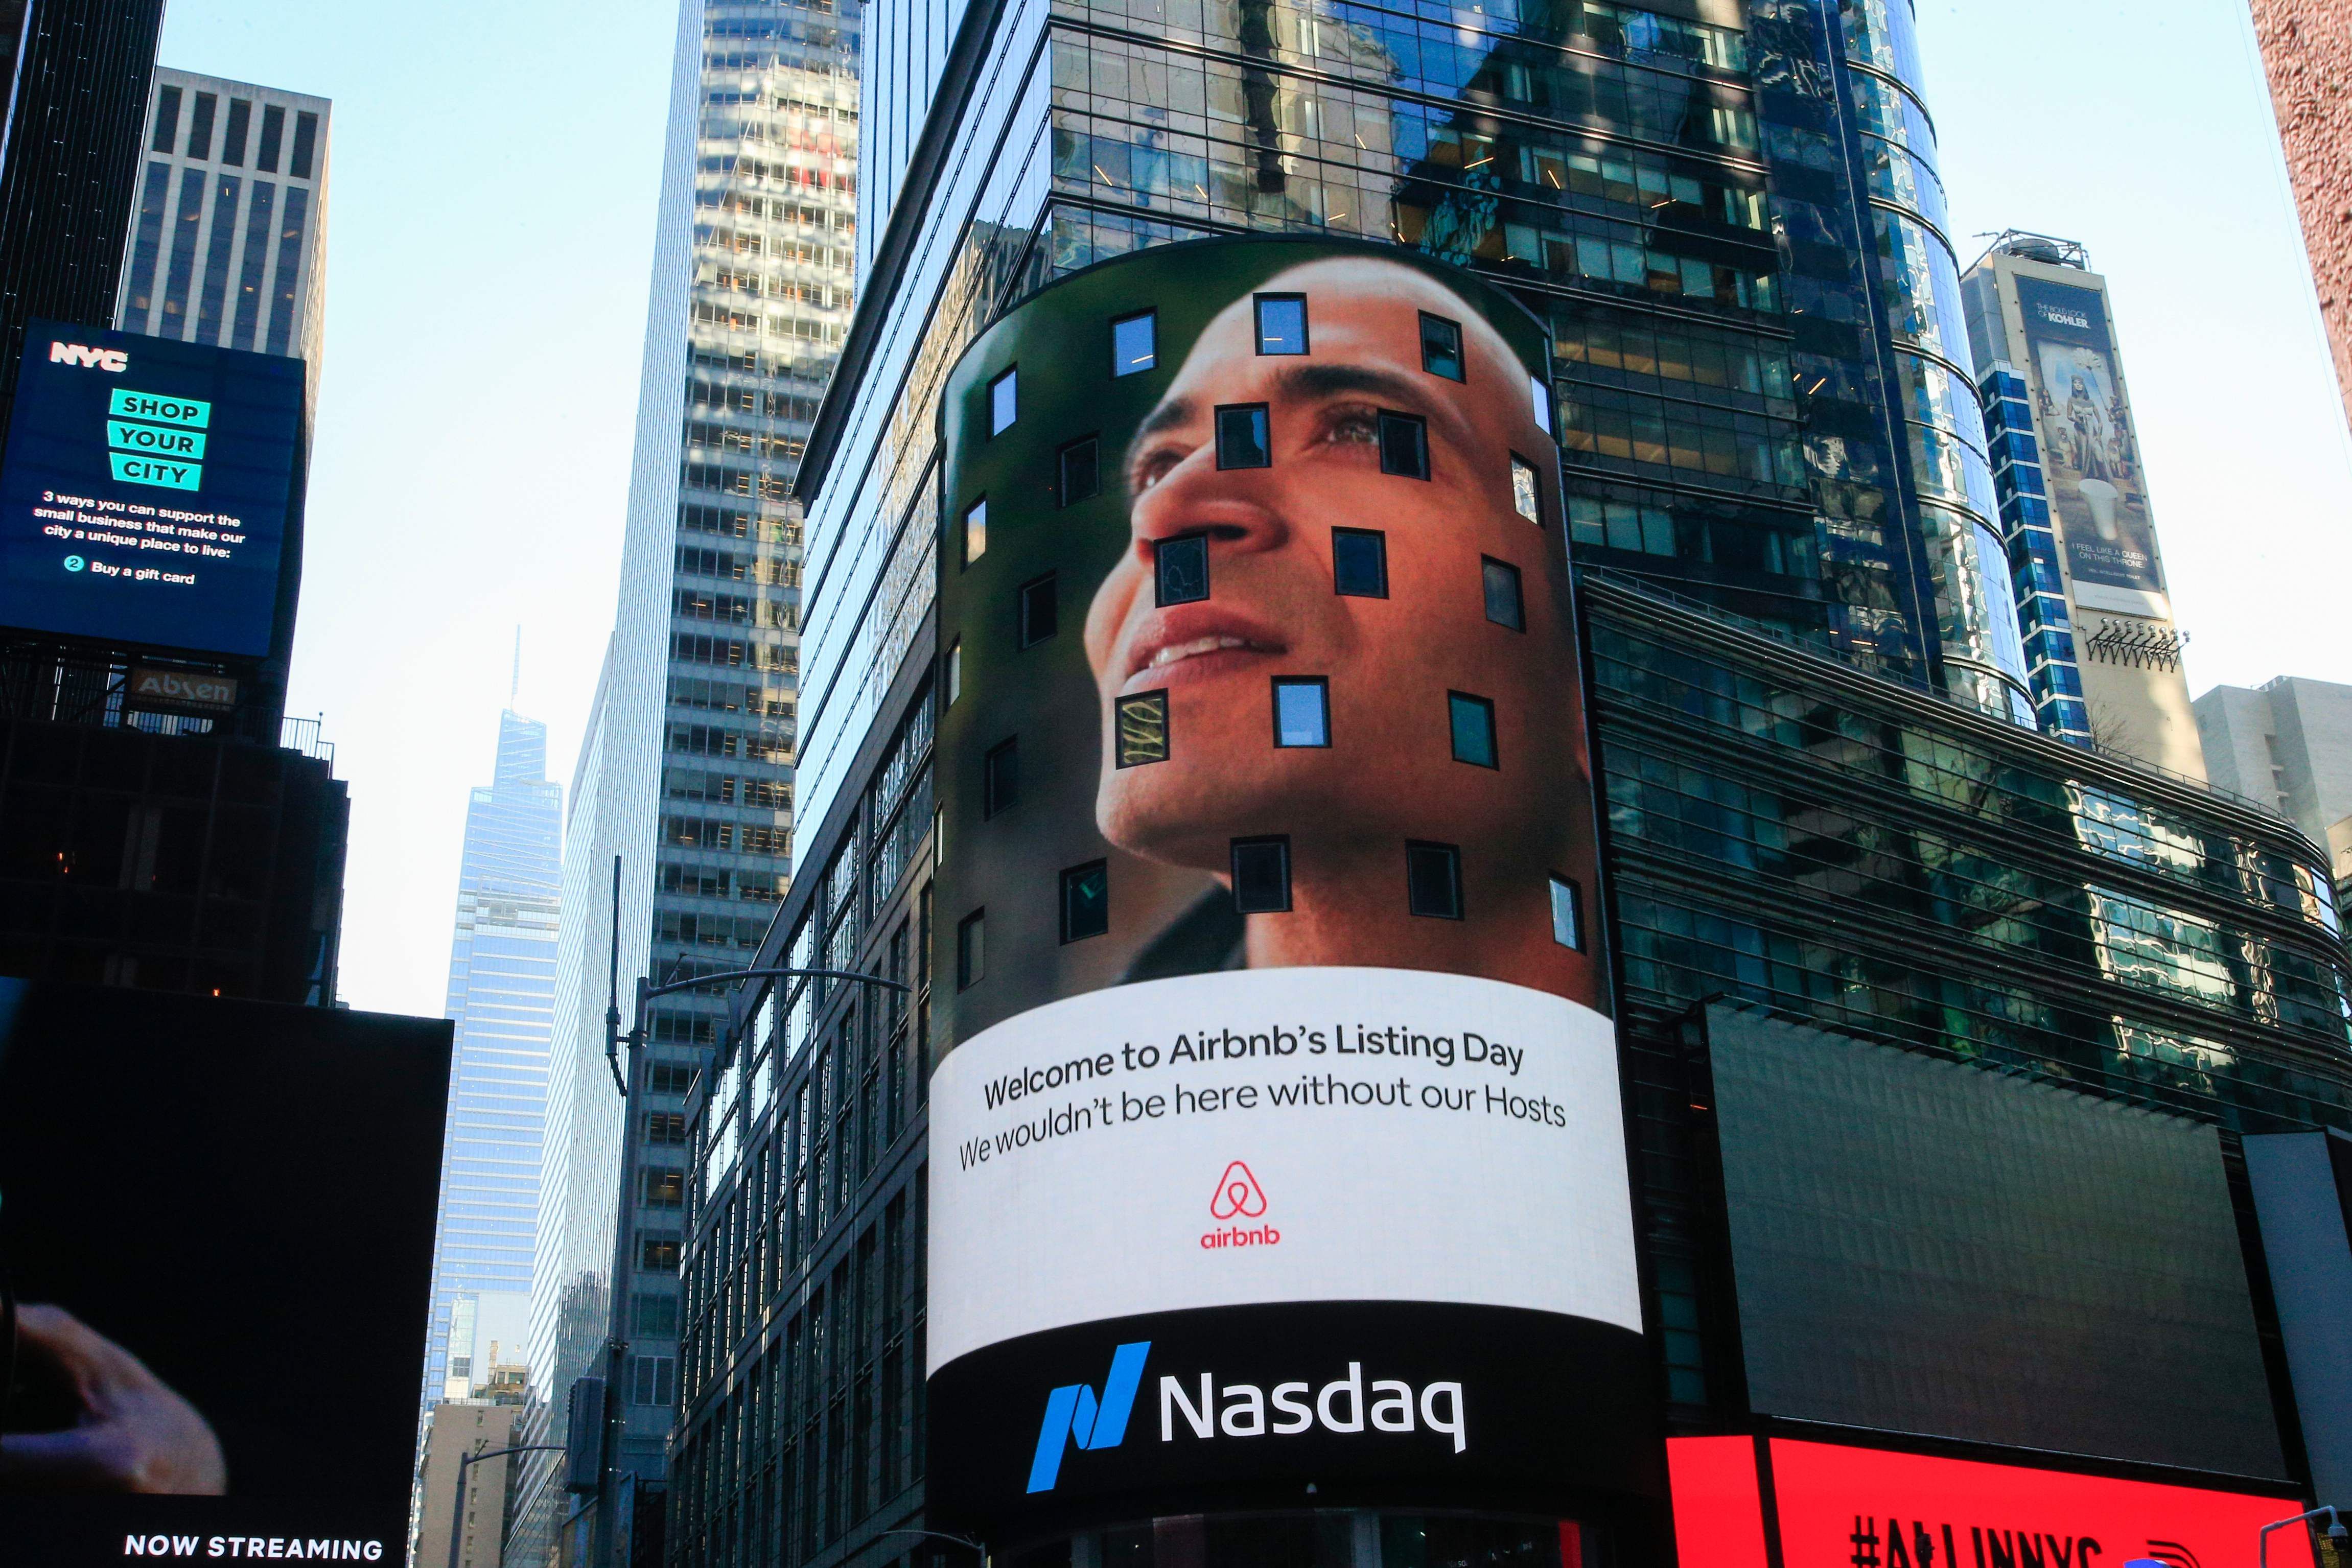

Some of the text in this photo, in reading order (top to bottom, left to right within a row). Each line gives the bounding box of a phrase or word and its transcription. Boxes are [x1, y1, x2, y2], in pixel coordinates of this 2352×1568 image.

[49, 341, 128, 372] NYC
[123, 397, 198, 420] SHOP
[120, 428, 194, 453] YOUR
[123, 461, 188, 483] CITY
[42, 491, 241, 527] 3 ways you can support the
[33, 508, 246, 544] small business that make our
[43, 524, 230, 558] city a unique place to live:
[2076, 543, 2095, 553] FEEL
[2097, 546, 2113, 556] LIKE
[2122, 551, 2148, 561] QUEEN
[69, 558, 195, 584] 2 Buy a gift card
[2079, 552, 2146, 569] ON THIS THRONE.
[984, 1024, 1523, 1111] Welcome to Airbnb's Listing Day
[960, 1073, 1566, 1172] We wouldn't be here without our Hosts
[1200, 1224, 1280, 1249] airbnb
[1160, 1362, 1466, 1454] Nasdaq
[125, 1535, 382, 1561] NOW STREAMING
